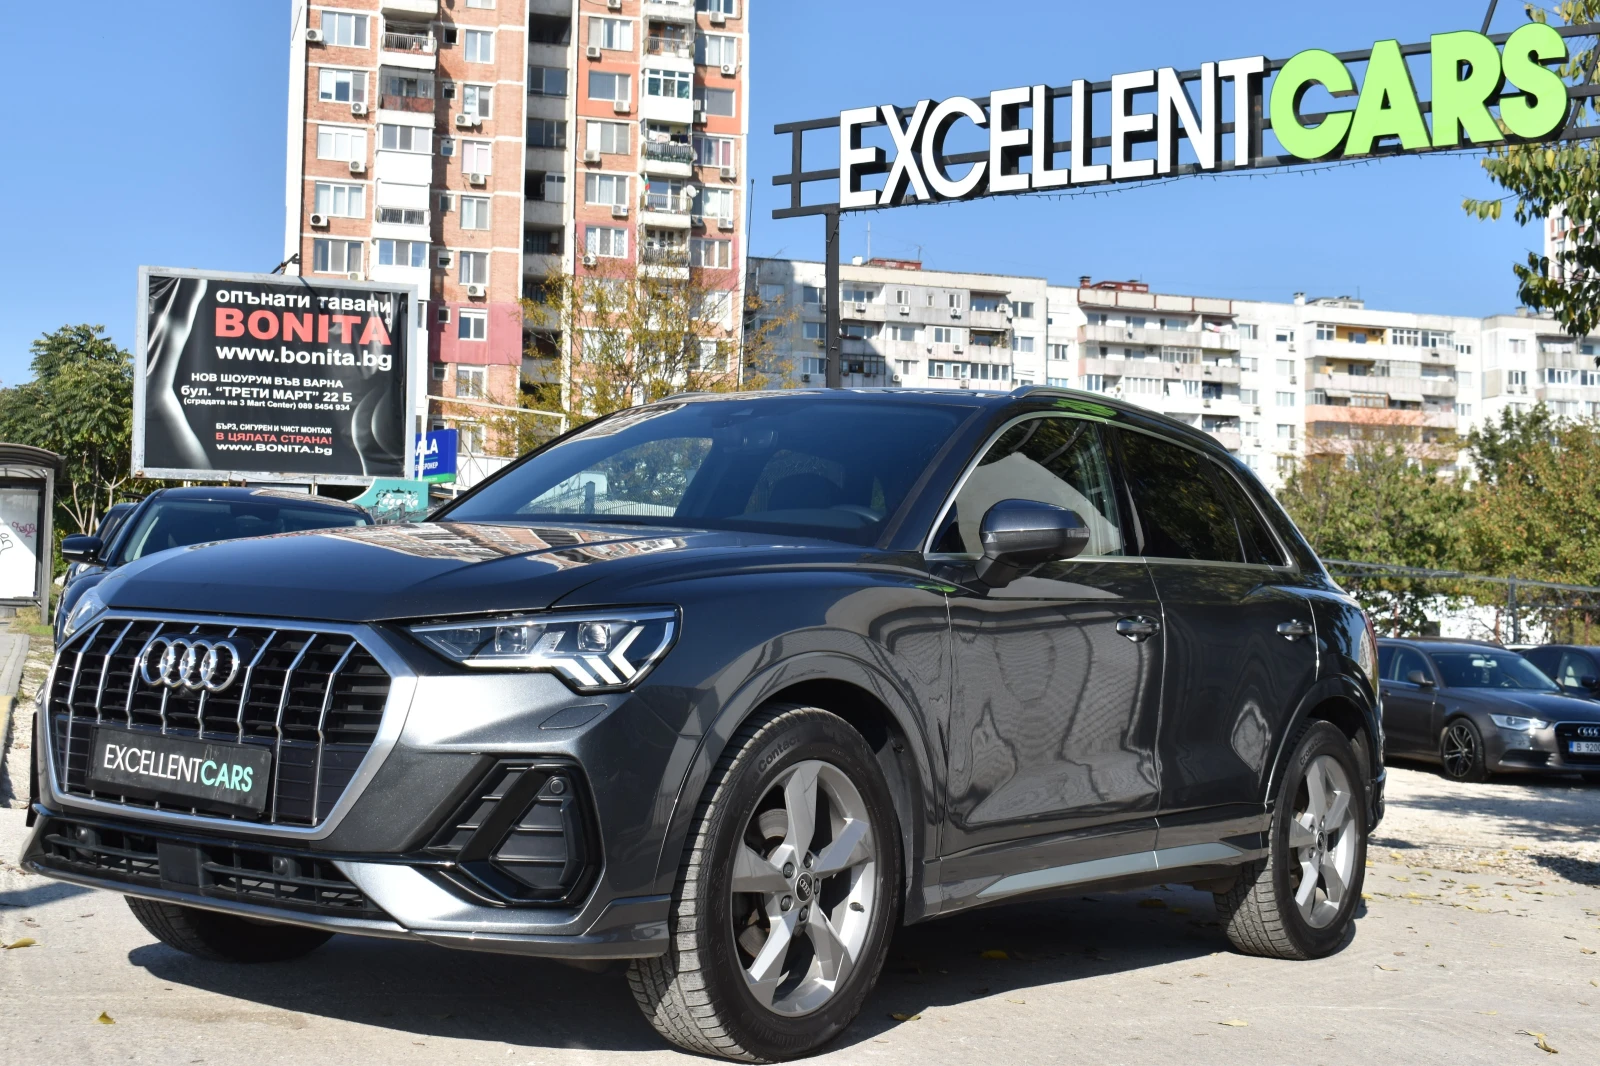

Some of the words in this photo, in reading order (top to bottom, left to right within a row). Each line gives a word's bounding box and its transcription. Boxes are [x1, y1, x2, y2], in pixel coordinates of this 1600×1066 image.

[215, 289, 310, 309] опънати
[318, 296, 391, 313] тавани
[215, 307, 392, 346] BONITA
[215, 346, 393, 371] www.bonita.bg
[191, 373, 218, 382] НОВ
[220, 374, 272, 385] ШОУРУМ
[274, 376, 301, 387] ВЪВ
[303, 378, 344, 389] ВАРНА
[180, 385, 212, 397] бул.
[322, 391, 339, 402] 22
[342, 392, 353, 403] Б
[183, 397, 226, 406] (сградата
[267, 400, 297, 410] Center)
[298, 402, 313, 410] 089
[314, 403, 334, 411] 5454
[335, 403, 350, 411] 934
[215, 422, 239, 431] БЪРЗ,
[239, 423, 273, 432] СИГУРЕН
[273, 424, 279, 432] И
[280, 424, 300, 433] ЧИСТ
[300, 426, 332, 434] МОНТАЖ
[215, 432, 225, 441] В
[227, 433, 278, 443] ЦЯЛАТА
[280, 434, 333, 445] СТРАНА!
[215, 443, 333, 456] www.BONITA.bg
[1577, 743, 1581, 751] B
